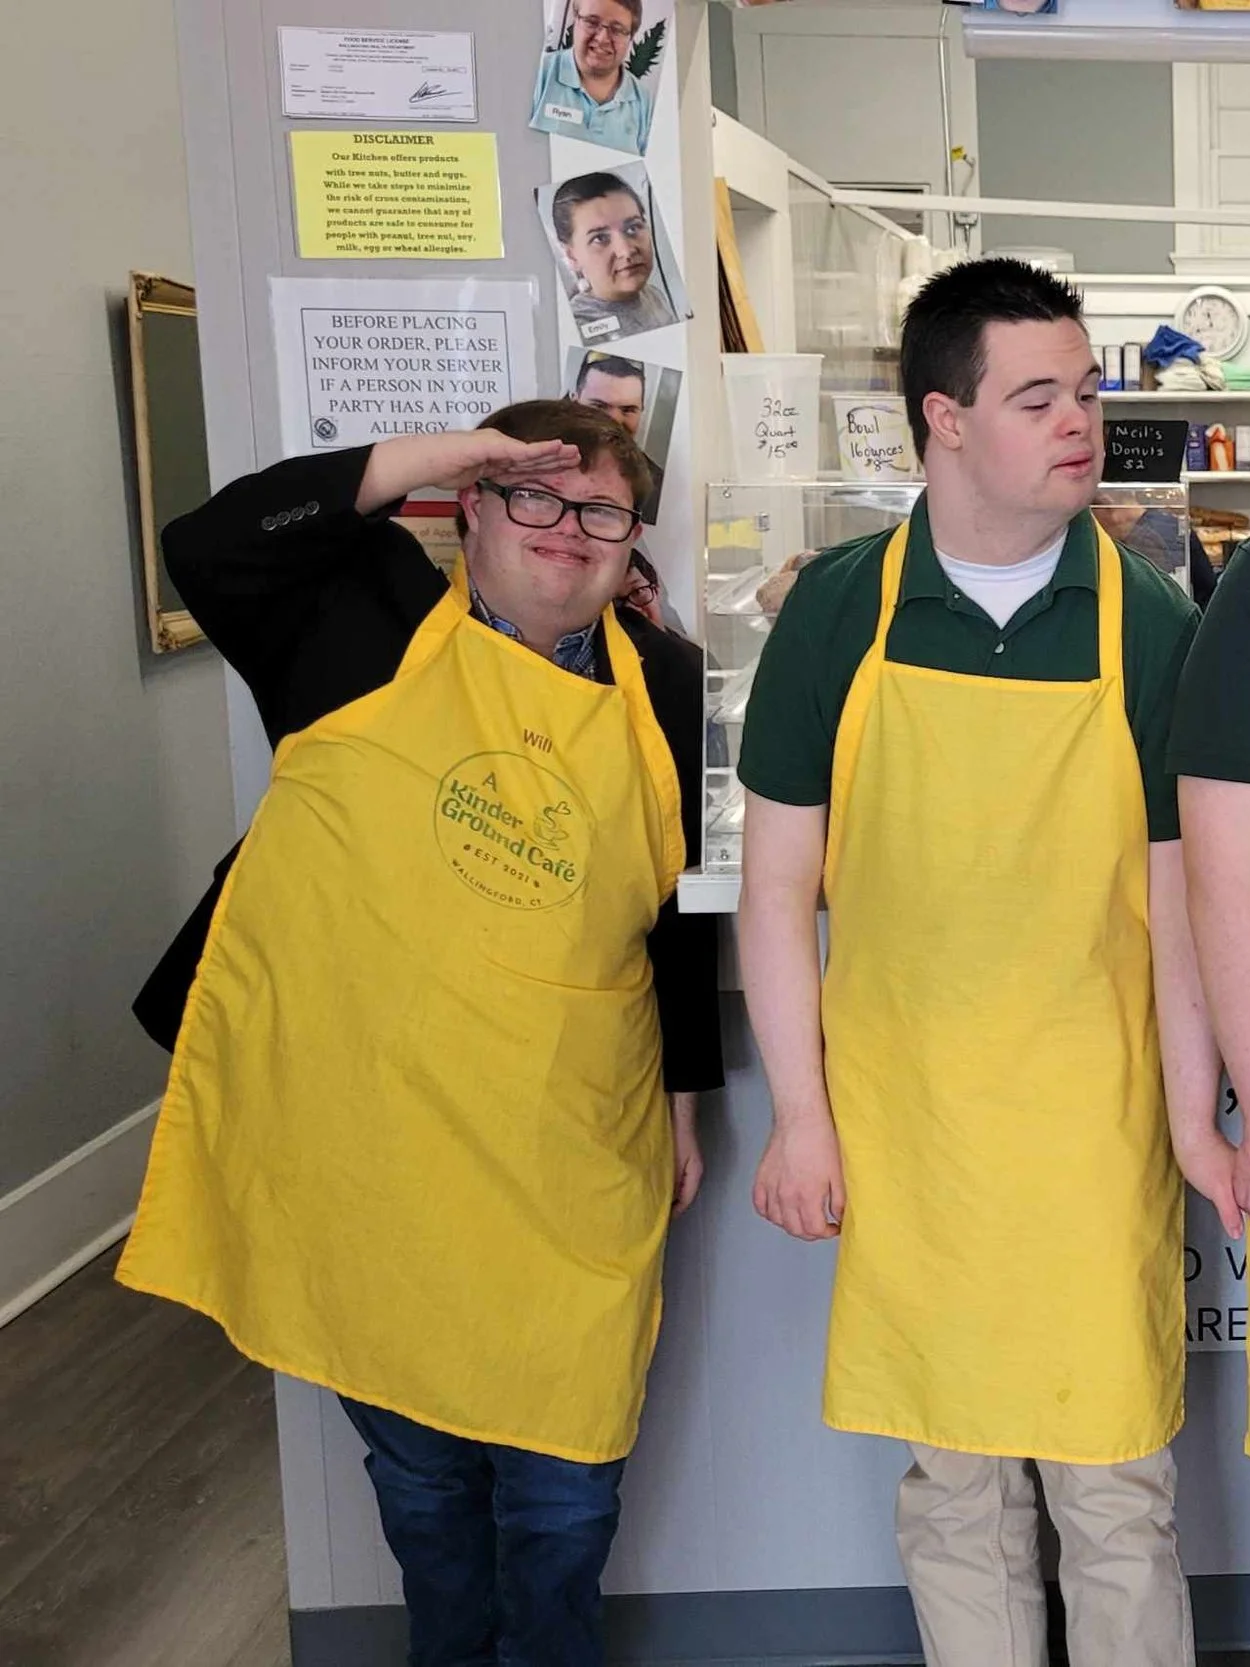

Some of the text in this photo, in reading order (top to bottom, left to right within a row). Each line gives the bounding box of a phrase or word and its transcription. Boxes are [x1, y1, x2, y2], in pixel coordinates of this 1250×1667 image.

[353, 134, 434, 145] DISCLAIMER
[332, 153, 459, 164] Our Kitchen offers products
[325, 169, 346, 177] with
[393, 170, 421, 178] butter
[423, 170, 440, 178] and
[442, 172, 467, 180] eggs.
[323, 181, 350, 189] While
[368, 182, 388, 190] take
[390, 183, 414, 192] steps
[428, 183, 471, 191] minimize
[326, 194, 341, 202] the
[343, 194, 361, 202] risk
[363, 194, 373, 202] of
[401, 195, 470, 204] contamination,
[376, 207, 421, 216] guarantee
[423, 207, 441, 215] that
[443, 208, 459, 217] any
[462, 207, 471, 216] of
[326, 219, 367, 228] products
[386, 219, 404, 227] safe
[460, 220, 473, 228] for
[325, 231, 356, 241] people
[359, 232, 378, 240] with
[363, 246, 381, 254] egg
[332, 315, 477, 330] BEFORE PLACING
[314, 336, 498, 352] YOUR ORDER, PLEASE
[312, 357, 503, 373] INFORM YOUR SERVER
[320, 378, 499, 394] IF A PERSON IN YOUR
[329, 399, 492, 414] PARTY HAS A FOOD
[370, 421, 449, 434] ALLERGY
[755, 421, 797, 438] Quart
[847, 413, 880, 434] Bowl
[1115, 426, 1163, 440] Neil's
[1111, 442, 1164, 457] Donuts
[1123, 459, 1145, 470] $2
[523, 728, 553, 753] Will
[482, 771, 498, 792] A
[450, 779, 524, 829] Kinder
[441, 797, 576, 882] Ground Café
[474, 849, 529, 883] EST 2021
